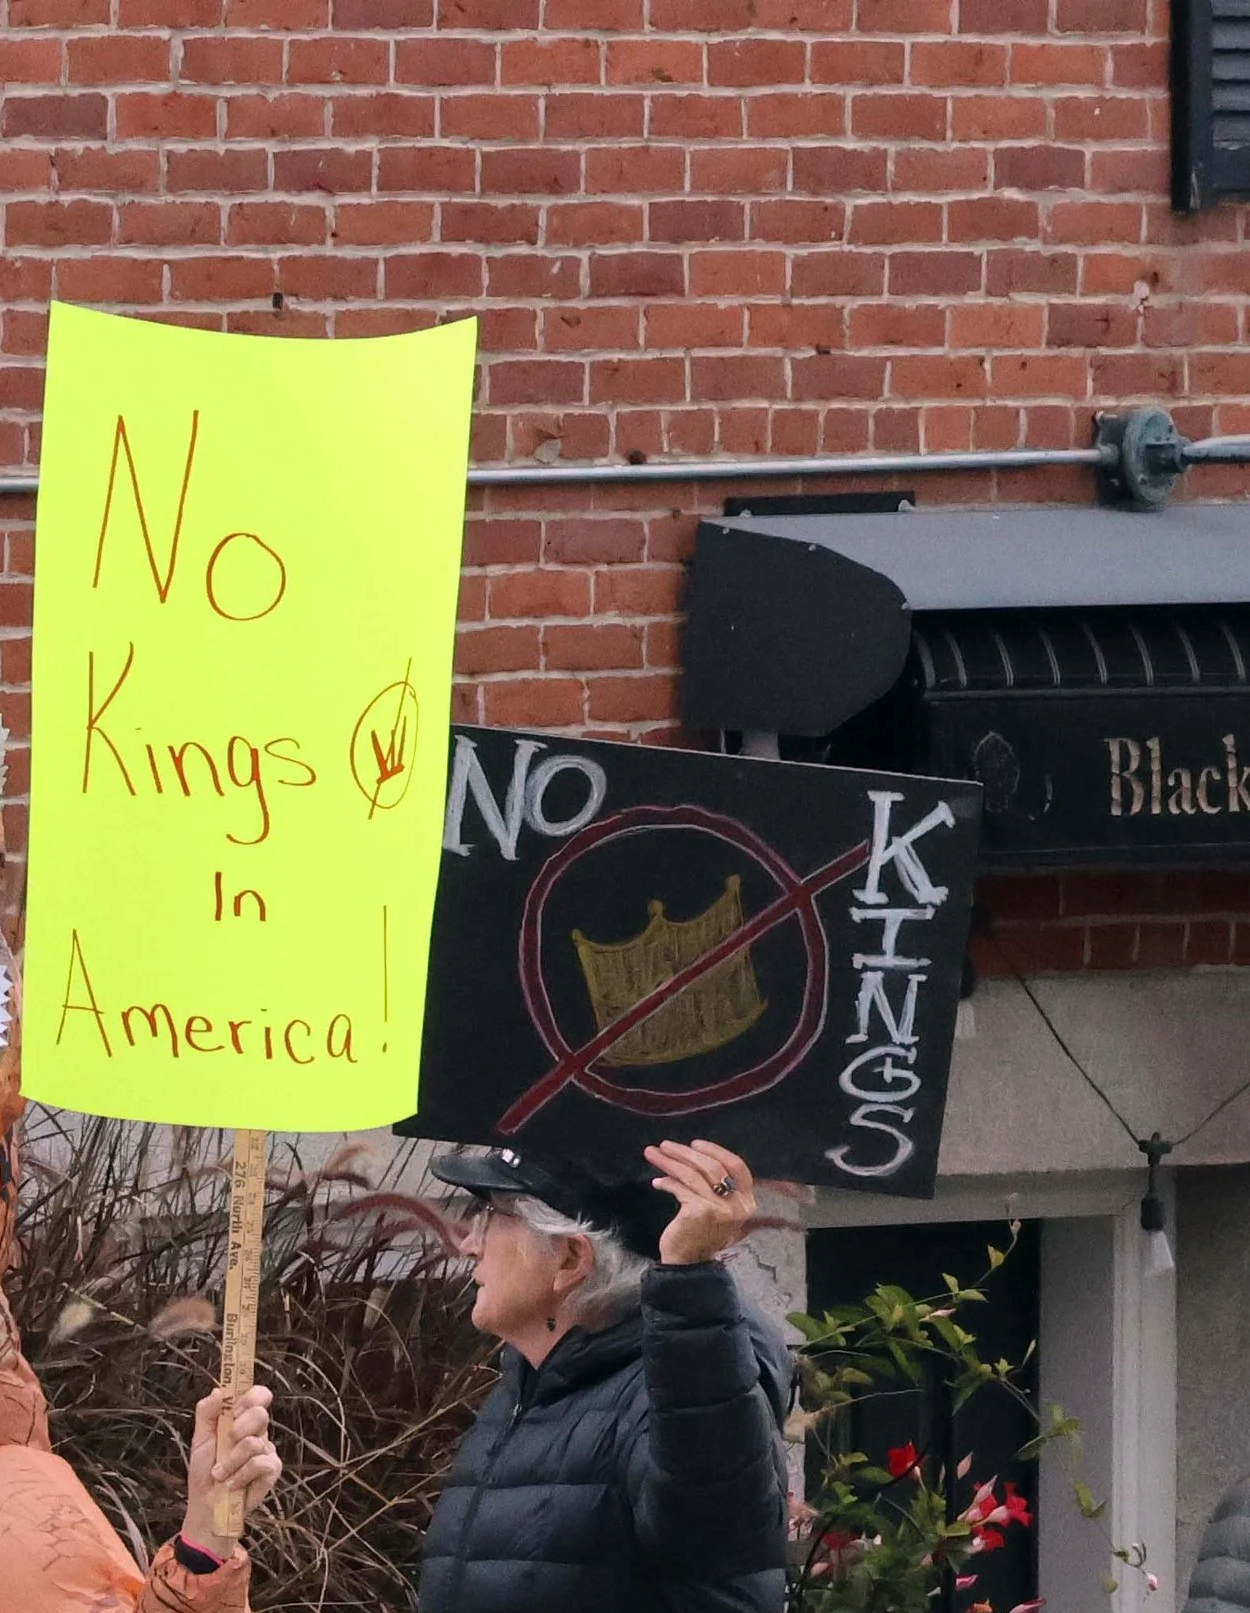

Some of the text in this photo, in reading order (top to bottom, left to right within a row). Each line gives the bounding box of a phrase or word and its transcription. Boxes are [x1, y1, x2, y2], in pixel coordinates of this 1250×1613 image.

[92, 409, 286, 621] No
[82, 641, 317, 846] Kings
[442, 734, 607, 861] NO
[214, 870, 267, 924] In
[55, 903, 390, 1066] America!
[823, 790, 956, 1177] KINGS
[230, 1194, 244, 1234] North
[233, 1160, 247, 1189] 276
[228, 1240, 242, 1271] Ave.
